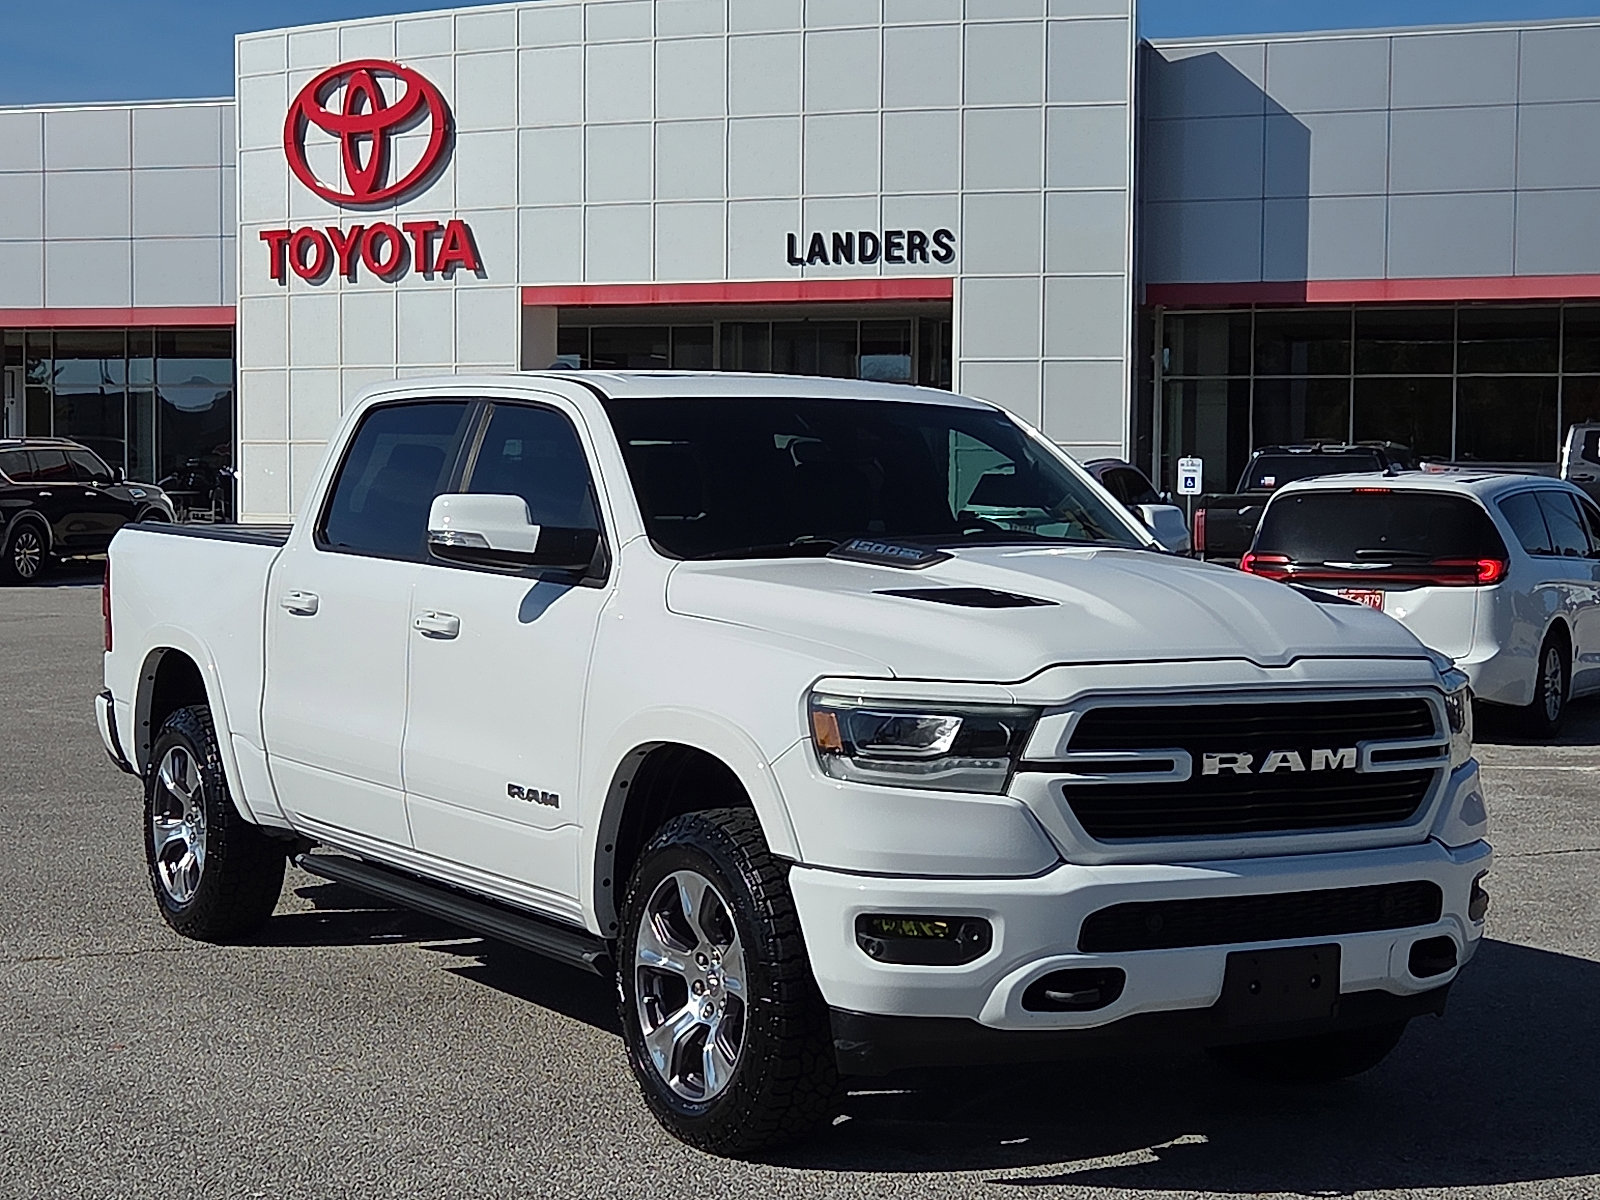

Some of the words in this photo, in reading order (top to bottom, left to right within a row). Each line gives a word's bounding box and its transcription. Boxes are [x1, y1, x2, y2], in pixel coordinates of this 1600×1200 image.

[260, 219, 482, 281] TOYOTA
[787, 229, 956, 265] LANDERS
[1202, 748, 1357, 775] RAM
[507, 783, 560, 809] RAM
